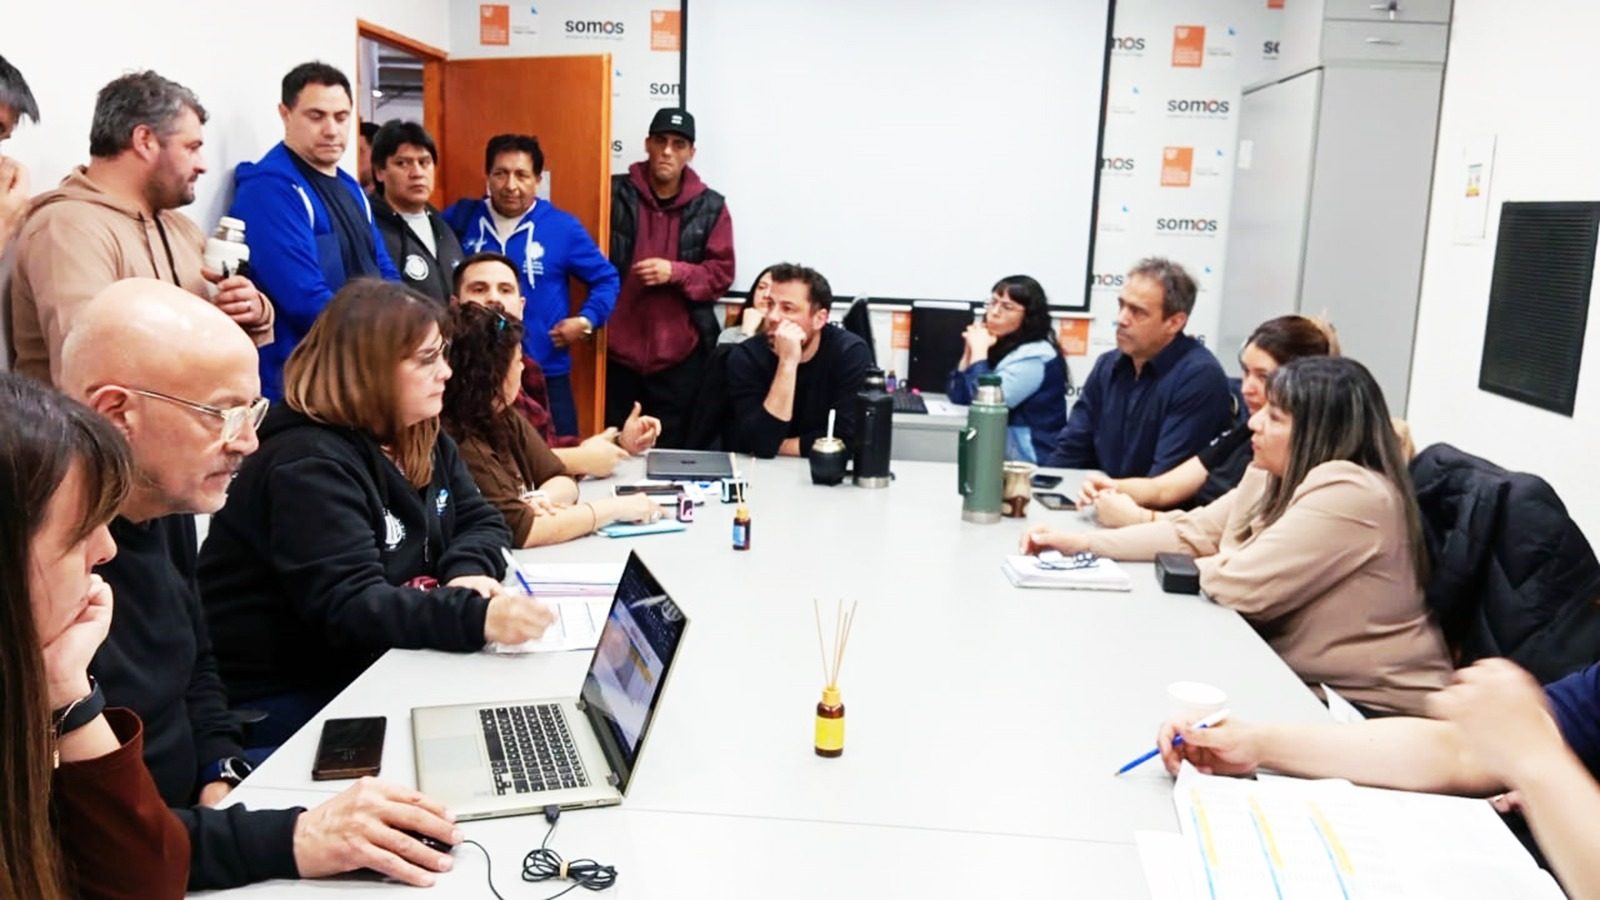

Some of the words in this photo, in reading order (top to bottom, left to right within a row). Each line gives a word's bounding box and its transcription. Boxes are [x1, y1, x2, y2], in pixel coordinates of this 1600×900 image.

[565, 20, 625, 34] somos
[1167, 99, 1229, 113] somos
[1157, 218, 1217, 231] somos
